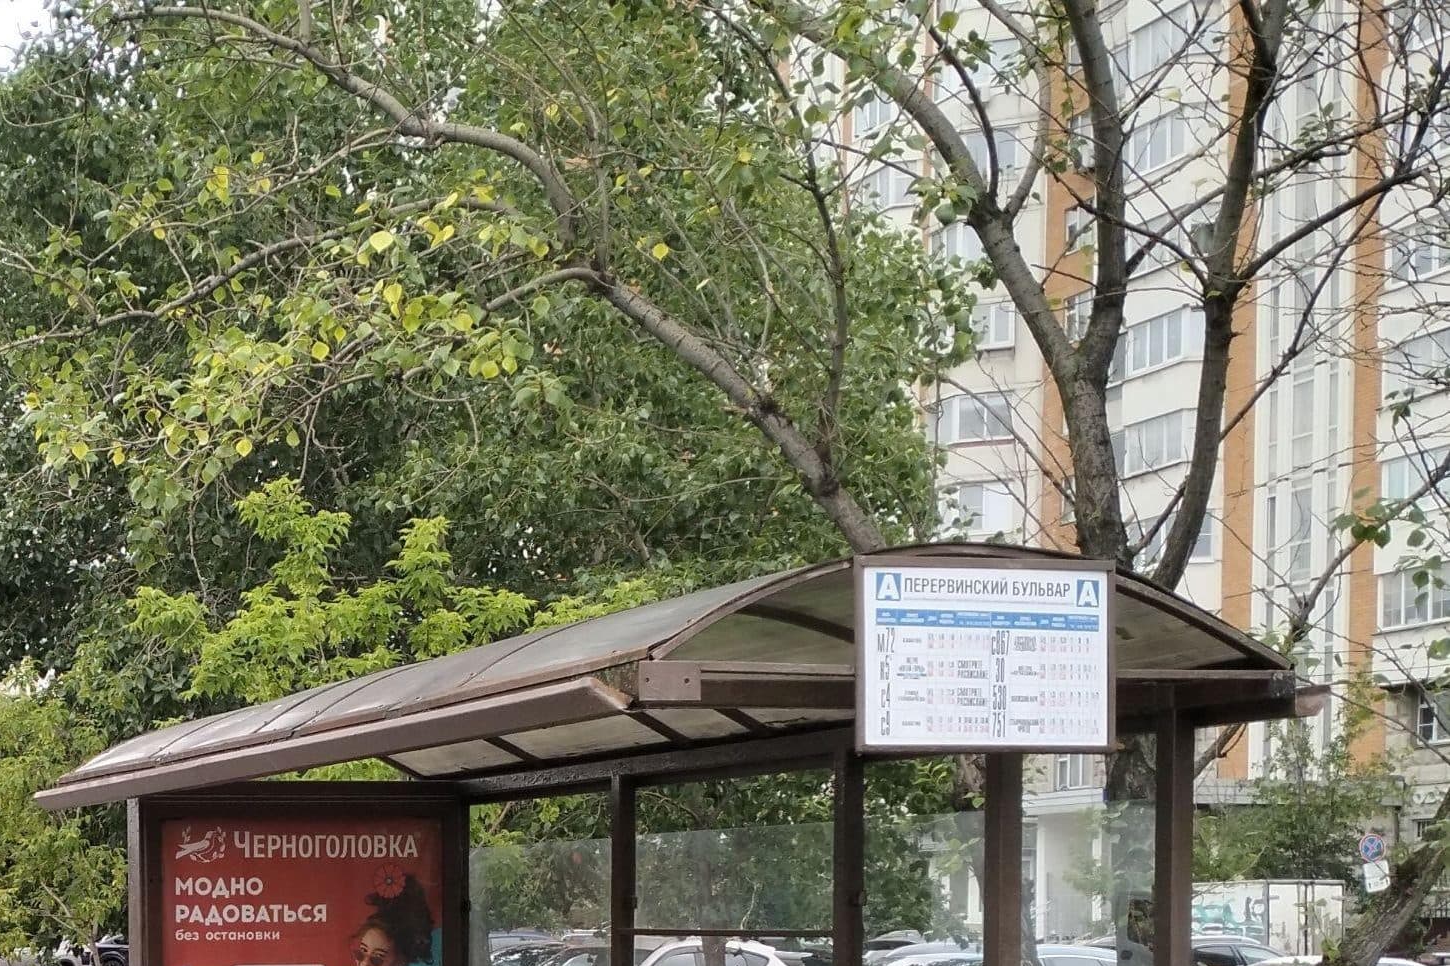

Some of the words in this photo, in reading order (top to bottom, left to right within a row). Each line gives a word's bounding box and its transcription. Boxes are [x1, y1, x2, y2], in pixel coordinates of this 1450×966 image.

[904, 577, 1009, 595] ПЕРЕРВИНСКИЙ
[1012, 581, 1071, 597] БУЛЬВАР
[995, 657, 1006, 683] 30
[992, 685, 1007, 711] 530
[992, 711, 1006, 738] 751
[233, 830, 419, 859] ЧЕРНОГОЛОВКА
[175, 876, 264, 899] МОДНО
[175, 903, 327, 926] РАДОВАТЬСЯ
[175, 929, 200, 941] без
[205, 930, 280, 941] остановки
